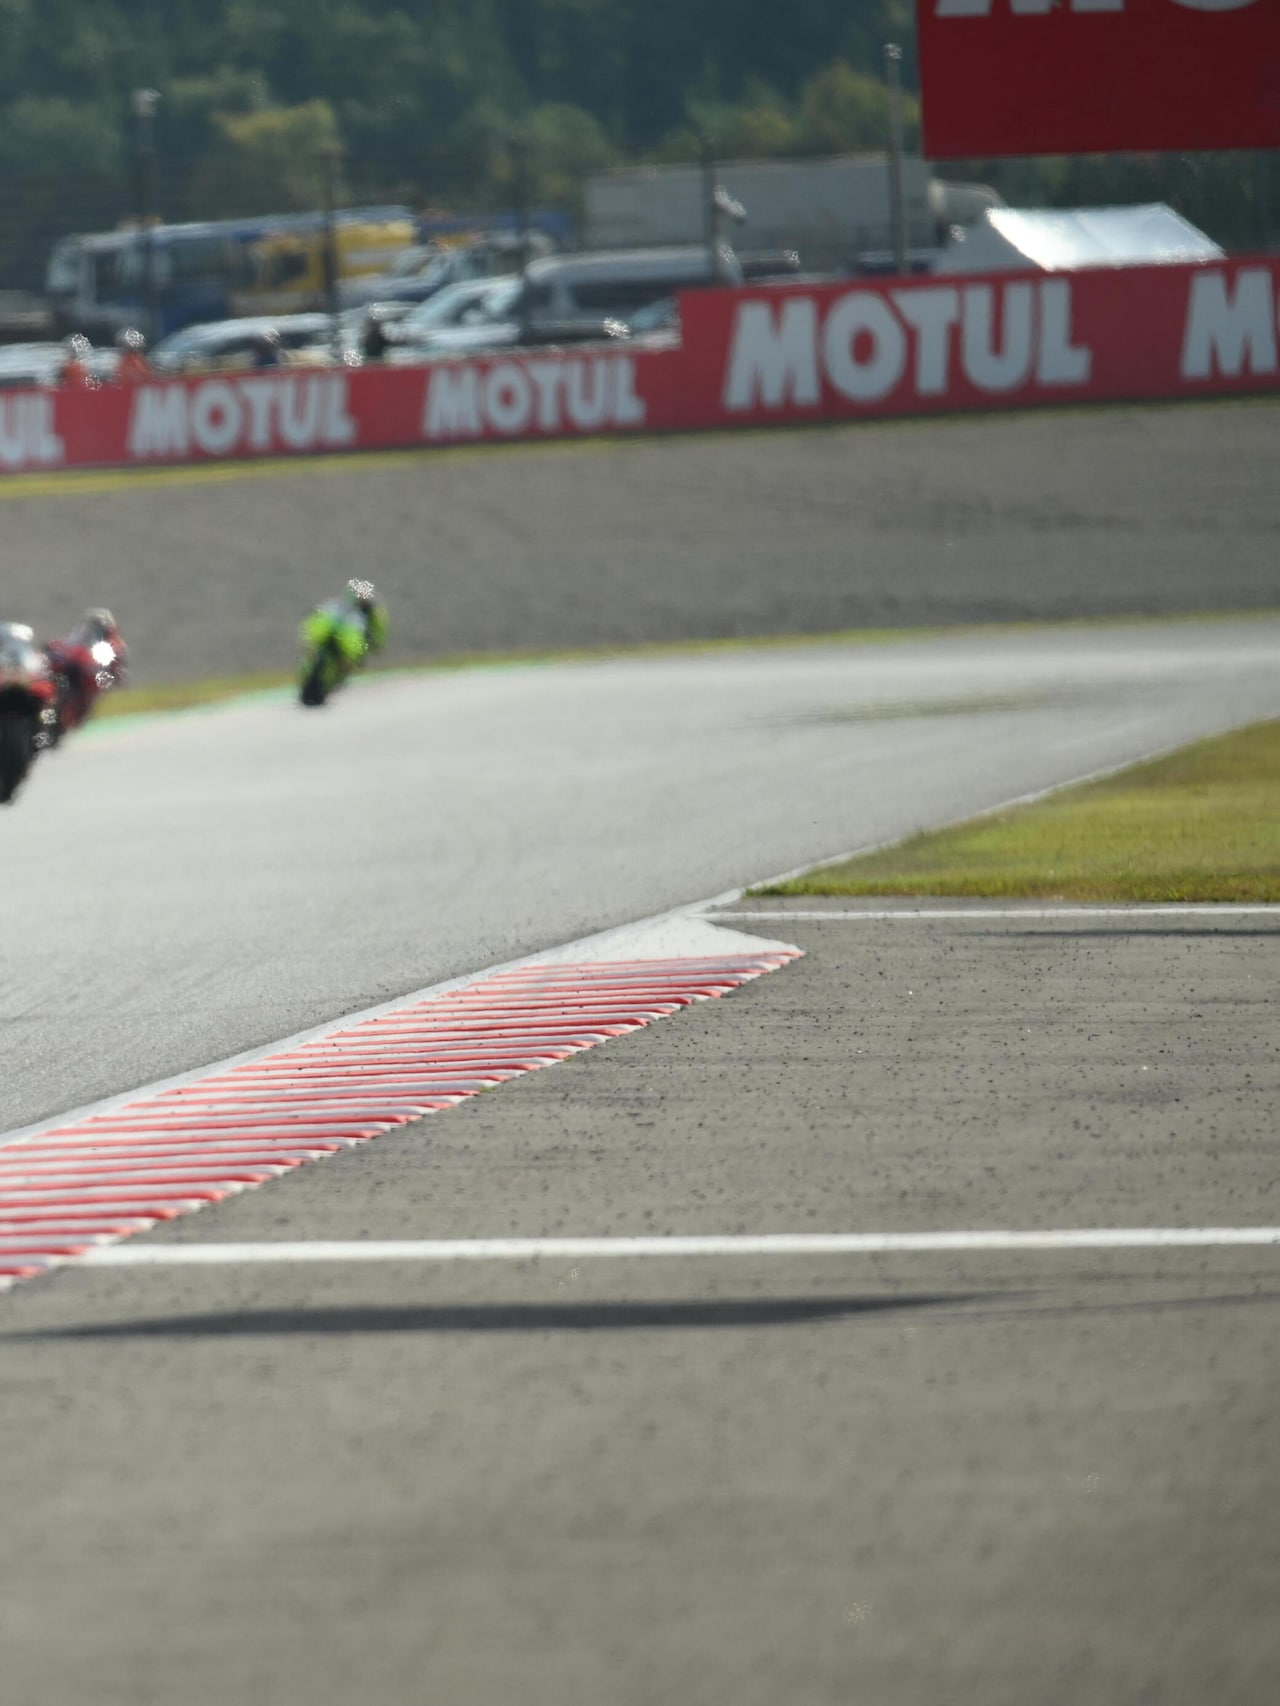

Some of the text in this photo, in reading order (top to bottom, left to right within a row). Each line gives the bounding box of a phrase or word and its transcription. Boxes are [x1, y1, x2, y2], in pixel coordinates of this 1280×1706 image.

[724, 277, 1092, 411] MOTUL
[126, 374, 354, 458] MOTUL
[422, 354, 648, 439] MOTUL
